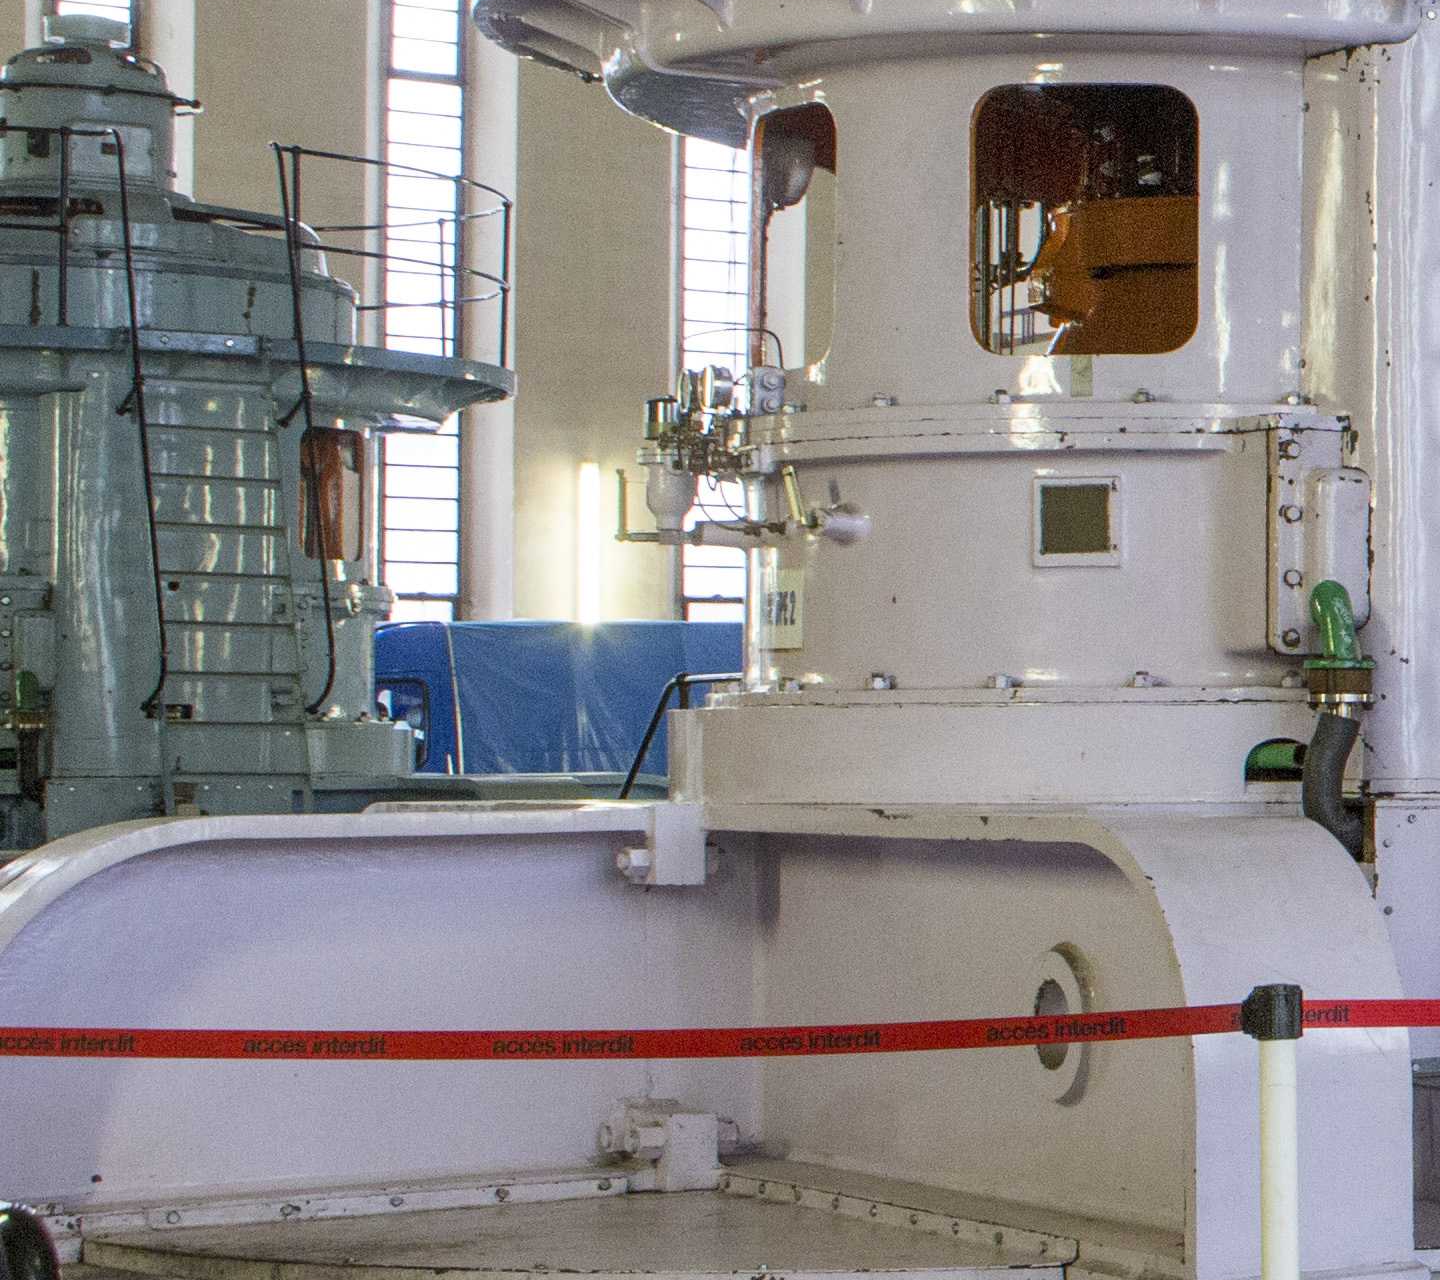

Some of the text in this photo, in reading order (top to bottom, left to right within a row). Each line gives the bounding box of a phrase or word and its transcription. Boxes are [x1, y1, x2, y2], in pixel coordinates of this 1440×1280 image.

[985, 1016, 1127, 1042] accès interdit
[60, 1033, 136, 1054] interdit
[243, 1035, 387, 1055] accès interdit
[492, 1034, 635, 1056] accès interdit
[740, 1029, 881, 1052] accès interdit
